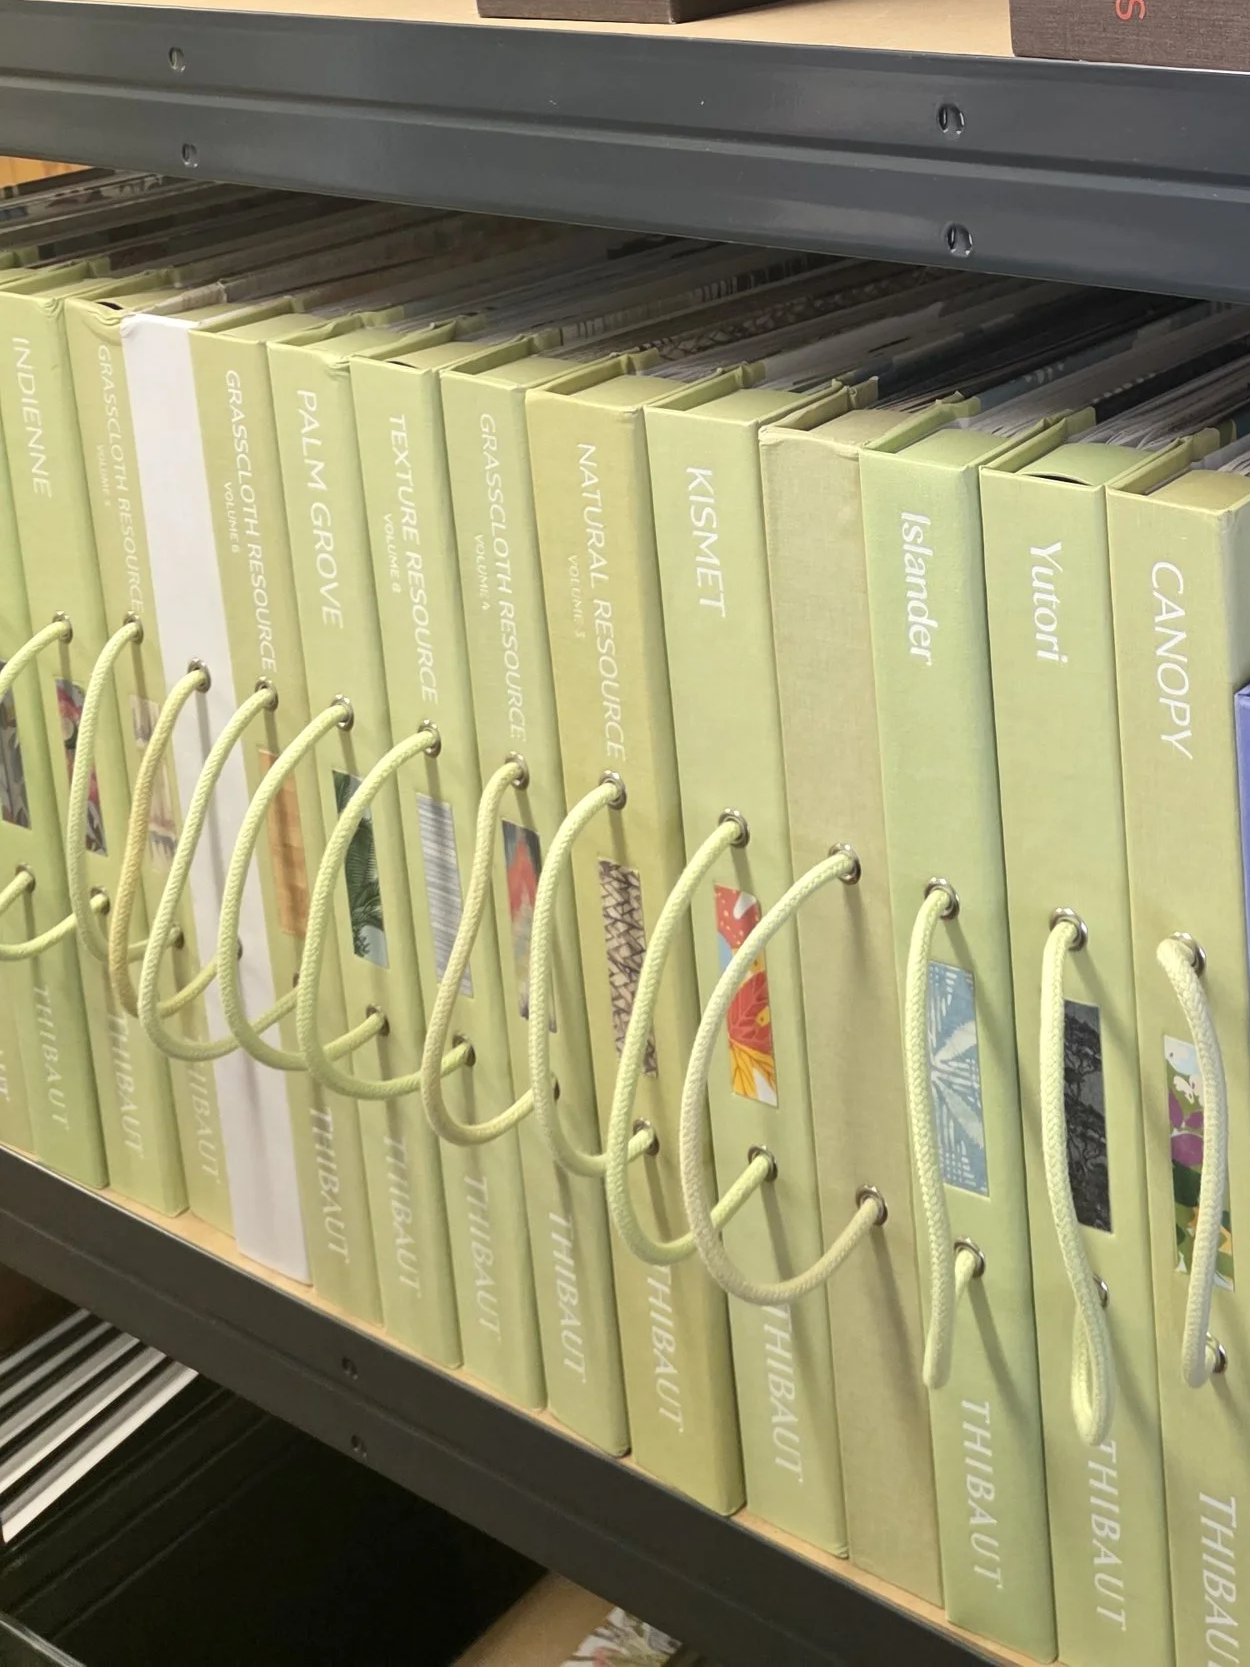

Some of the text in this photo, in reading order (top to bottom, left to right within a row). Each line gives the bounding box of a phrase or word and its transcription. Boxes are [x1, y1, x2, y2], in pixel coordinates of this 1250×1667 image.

[13, 337, 52, 499] INDIENNE
[98, 345, 144, 614] GRASSCLOTH RESOURCE
[224, 481, 239, 543] VOLUME
[225, 368, 277, 673] GRASSCLOTH RESOURCE
[296, 389, 344, 629] PALM GROVE
[383, 513, 400, 580] VOLUME
[389, 413, 438, 705] TEXTURE RESOURCE
[474, 534, 490, 599] VOLUME
[480, 413, 527, 742] GRASSCLOTH RESOURCE
[685, 466, 726, 618] KISMET
[900, 511, 939, 667] Islander
[577, 443, 626, 763] NATURAL RESOURCE
[1029, 541, 1068, 666] Yutori
[1151, 560, 1194, 761] CANOPY
[33, 984, 70, 1131] THIBAUT
[107, 1013, 144, 1159] THIBAUT
[186, 1036, 222, 1185] IBAUT
[309, 1105, 352, 1264] THIBAUT
[384, 1134, 421, 1298] THIBAUT
[463, 1174, 503, 1343] THIBAUT
[548, 1211, 587, 1383] THIBAUT
[645, 1264, 685, 1433] THIBAUT
[761, 1304, 804, 1484] THIBAUT
[960, 1399, 1005, 1591] THIBAUT
[1087, 1438, 1128, 1632] THIBAUT
